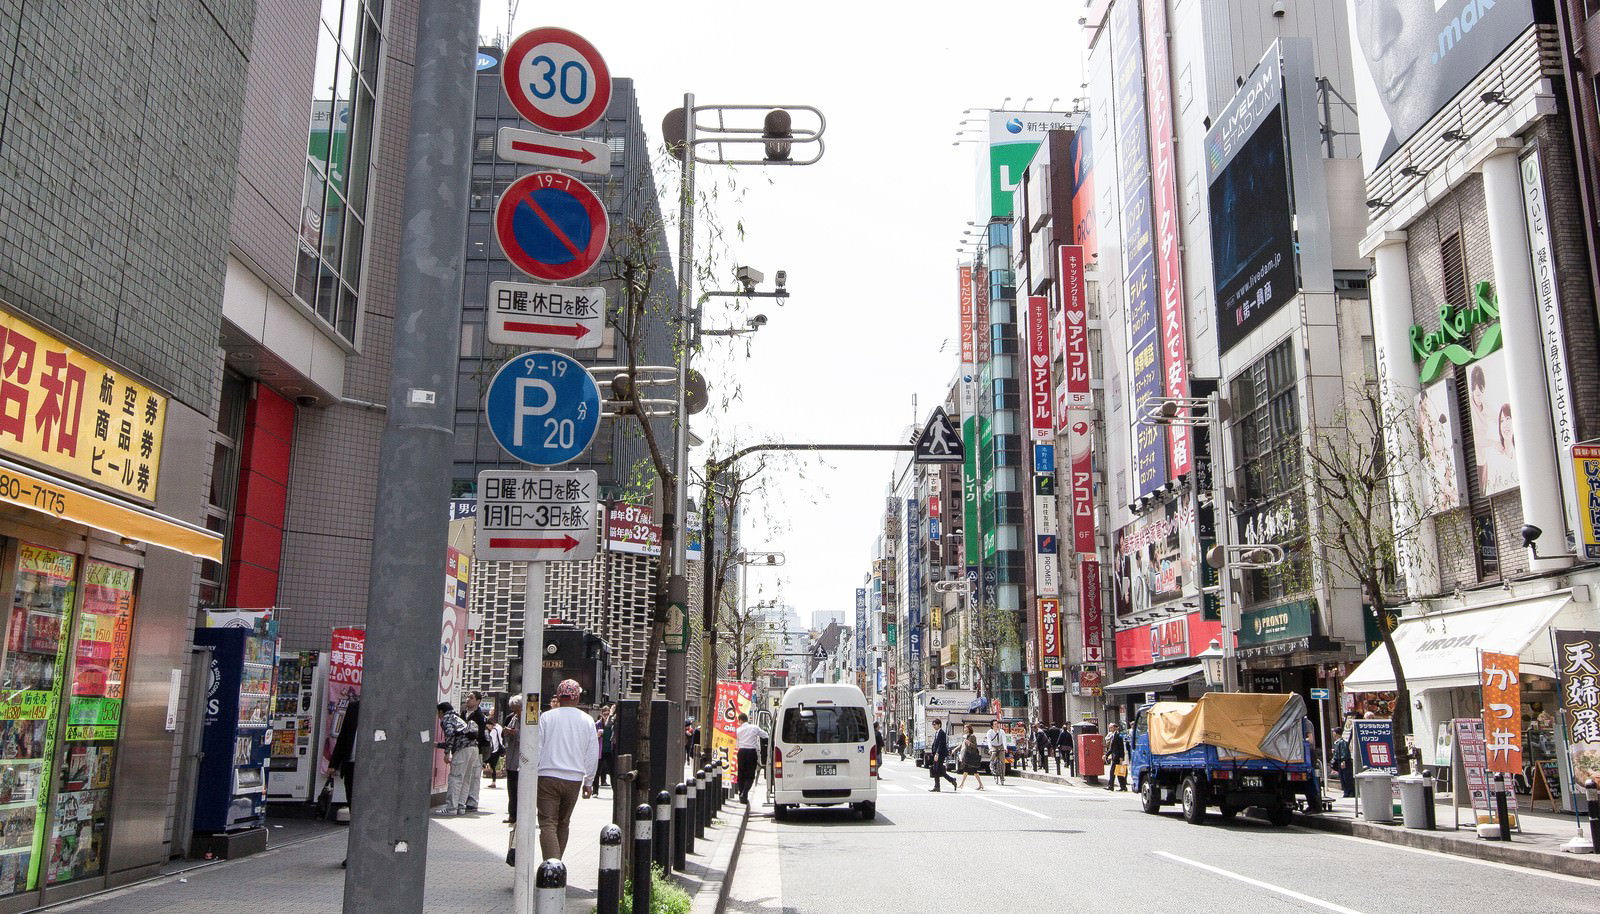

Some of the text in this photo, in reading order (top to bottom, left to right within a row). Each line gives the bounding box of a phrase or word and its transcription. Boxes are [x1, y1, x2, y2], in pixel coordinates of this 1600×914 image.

[530, 55, 587, 104] 30
[1222, 66, 1273, 141] LIVEDAM
[1223, 84, 1274, 157] STADIUM
[537, 175, 572, 191] 19-1
[1068, 255, 1078, 307] キャッシングなら
[1130, 269, 1148, 305] テレビ
[1236, 252, 1281, 299] www.livedam.jp
[961, 269, 973, 361] にしだクリニック新橋
[1243, 281, 1272, 320] 第一興商
[1035, 306, 1043, 352] キャッシングなら
[525, 358, 567, 378] 9-19
[1068, 325, 1086, 381] アイフル
[99, 372, 158, 426] 航空券
[513, 377, 557, 447] P
[577, 402, 587, 420] 分
[1034, 368, 1050, 419] アイフル
[95, 409, 154, 460] 商品券
[543, 418, 574, 449] 20
[1138, 425, 1159, 452] デジカメ
[91, 446, 150, 494] ビール券
[966, 474, 975, 502] レイク
[0, 474, 66, 514] 80-7175
[1075, 472, 1091, 516] アコム
[86, 562, 130, 588] 安く売ります
[1044, 556, 1052, 586] PROMISE
[1043, 602, 1057, 654] ナポリタン
[1262, 613, 1288, 628] PRONTO
[1416, 634, 1478, 652] HIROTA
[107, 591, 129, 697] 当店販売価格
[1565, 641, 1600, 743] 天婦羅
